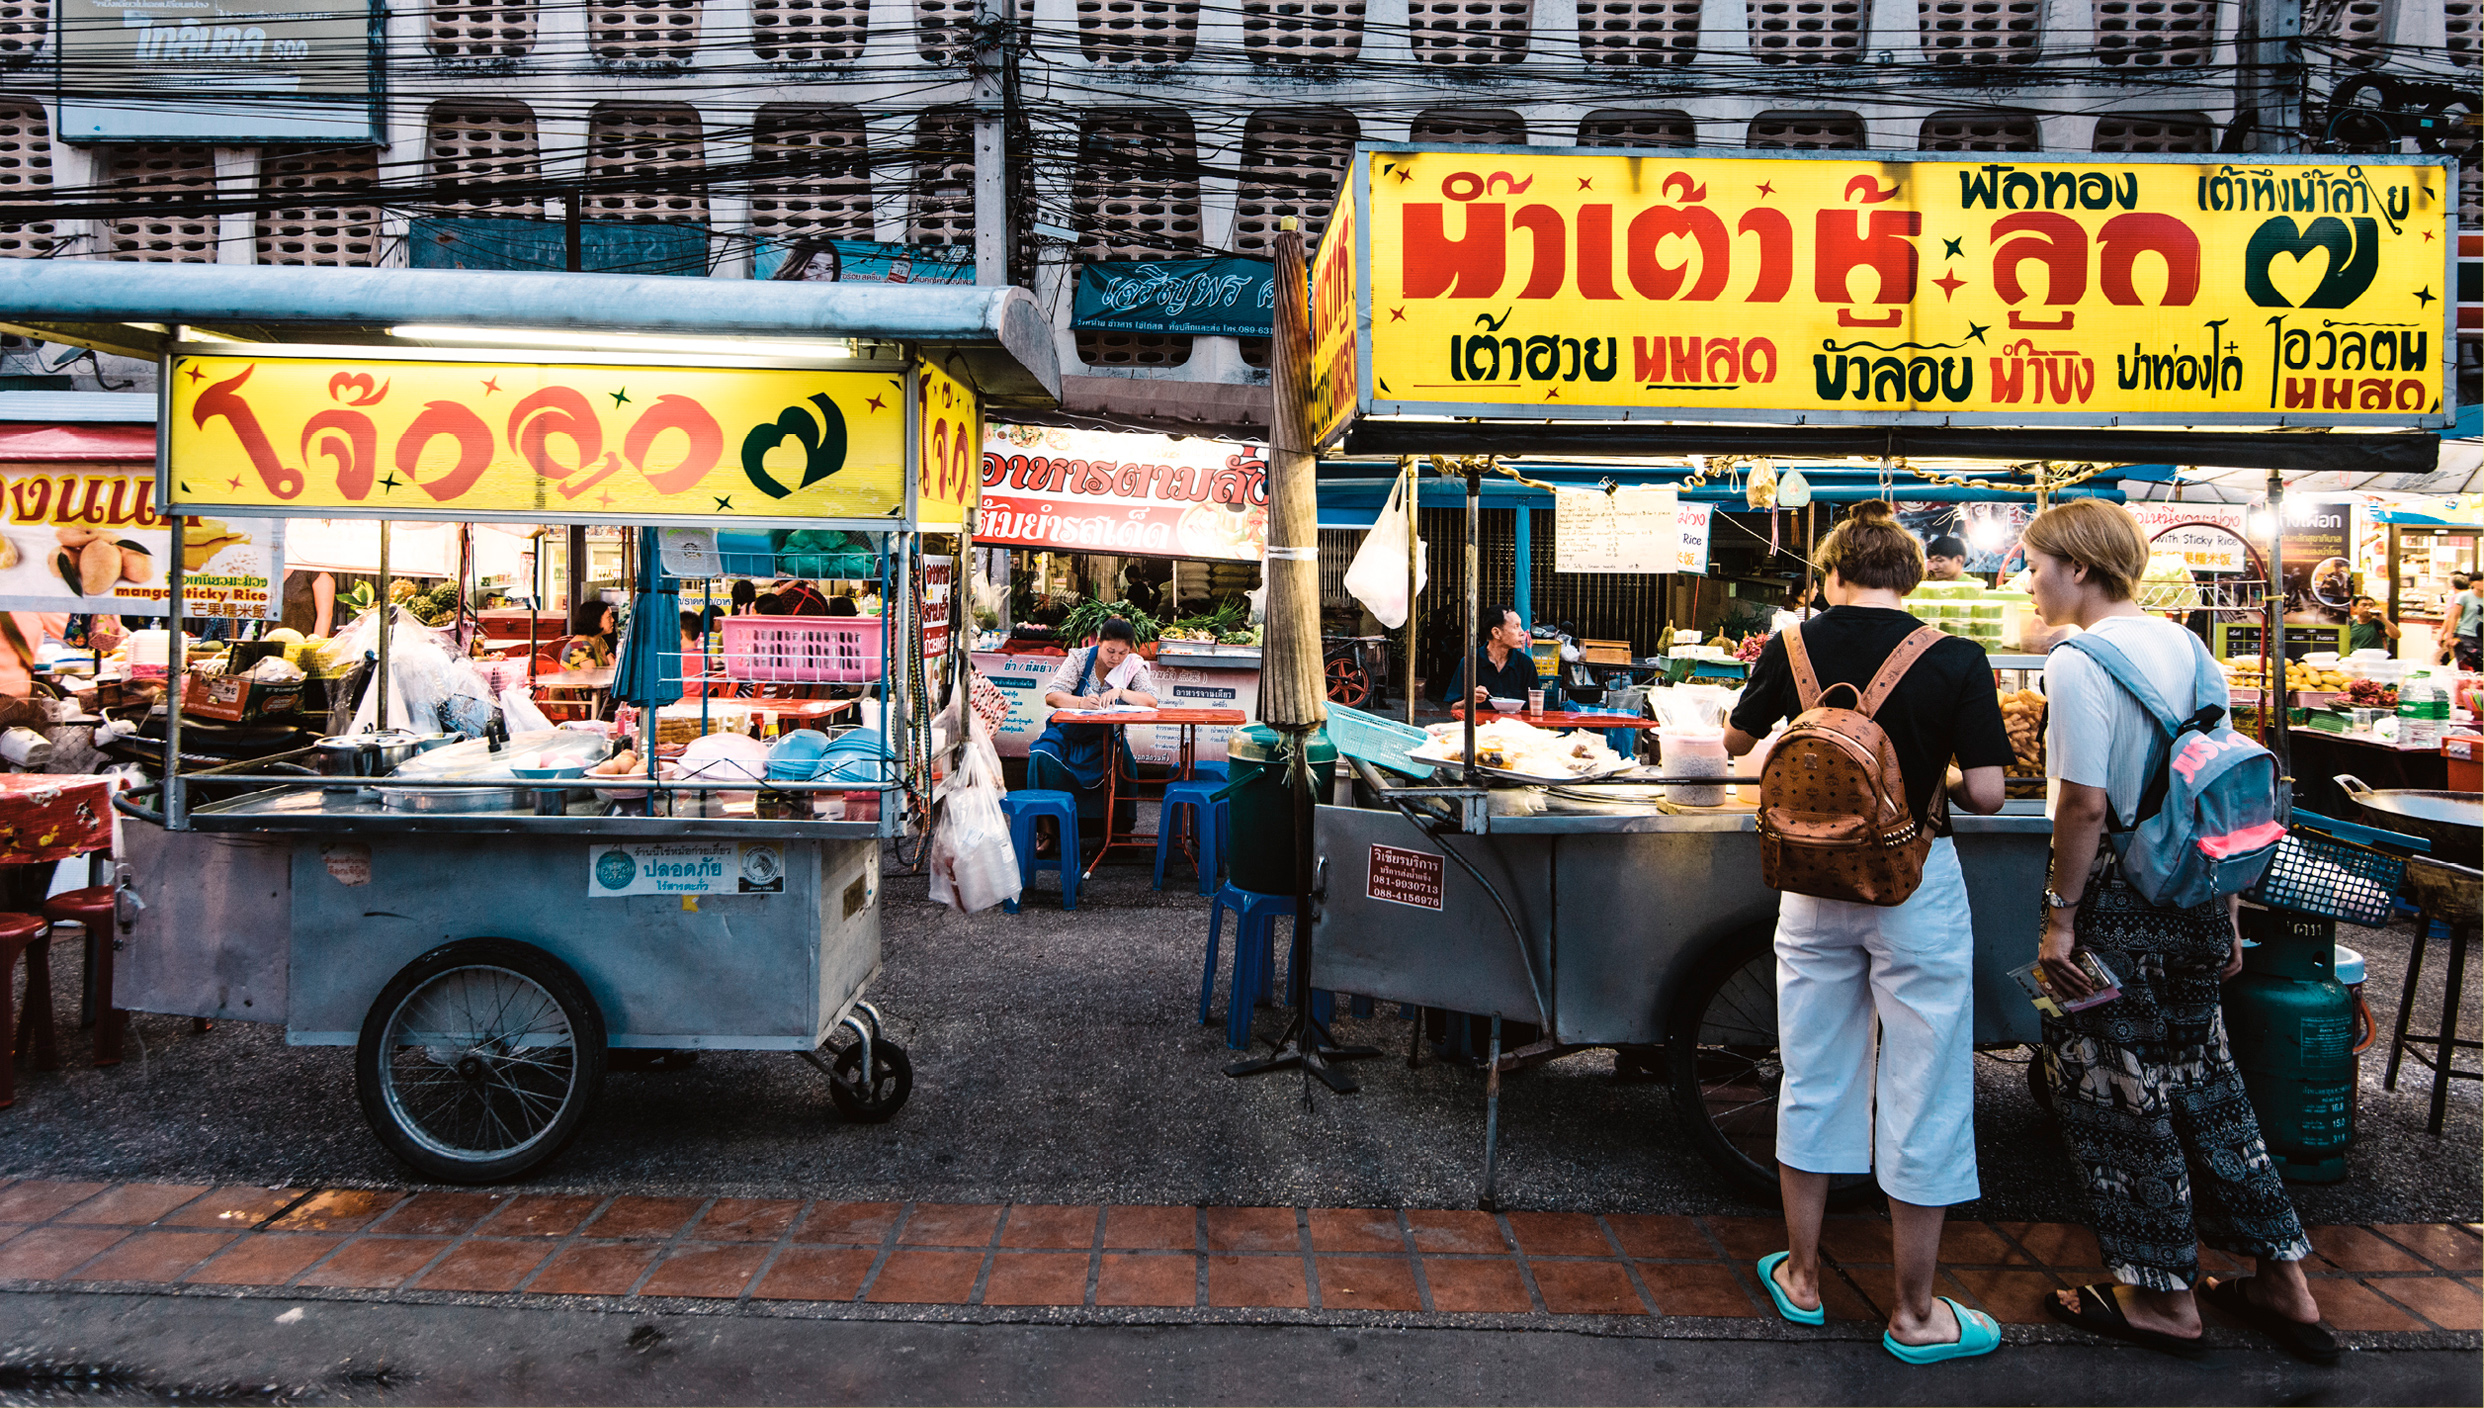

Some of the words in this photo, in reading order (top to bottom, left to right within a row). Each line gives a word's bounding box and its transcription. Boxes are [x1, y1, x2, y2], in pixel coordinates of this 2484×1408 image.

[271, 38, 309, 61] 500
[1990, 211, 2201, 330] ลูก
[1451, 307, 1617, 382] เต้าฮวย
[1633, 336, 1778, 384] นมสด
[1812, 338, 1973, 403] บัวลอย
[2285, 377, 2426, 411] นมสด
[1683, 532, 1702, 546] Rice
[2183, 533, 2213, 547] Sticky
[2217, 534, 2239, 547] Rice
[183, 587, 228, 602] ticky
[234, 588, 268, 601] Rice
[191, 602, 268, 619] 芒果糯米飯
[1175, 688, 1232, 699] อาหารจานเดียว
[643, 856, 722, 877] ปลอดภัย
[1374, 847, 1438, 871] วิเชียรบริการ
[1373, 875, 1438, 894] 081-9930713
[1374, 887, 1439, 907] 088-4156976
